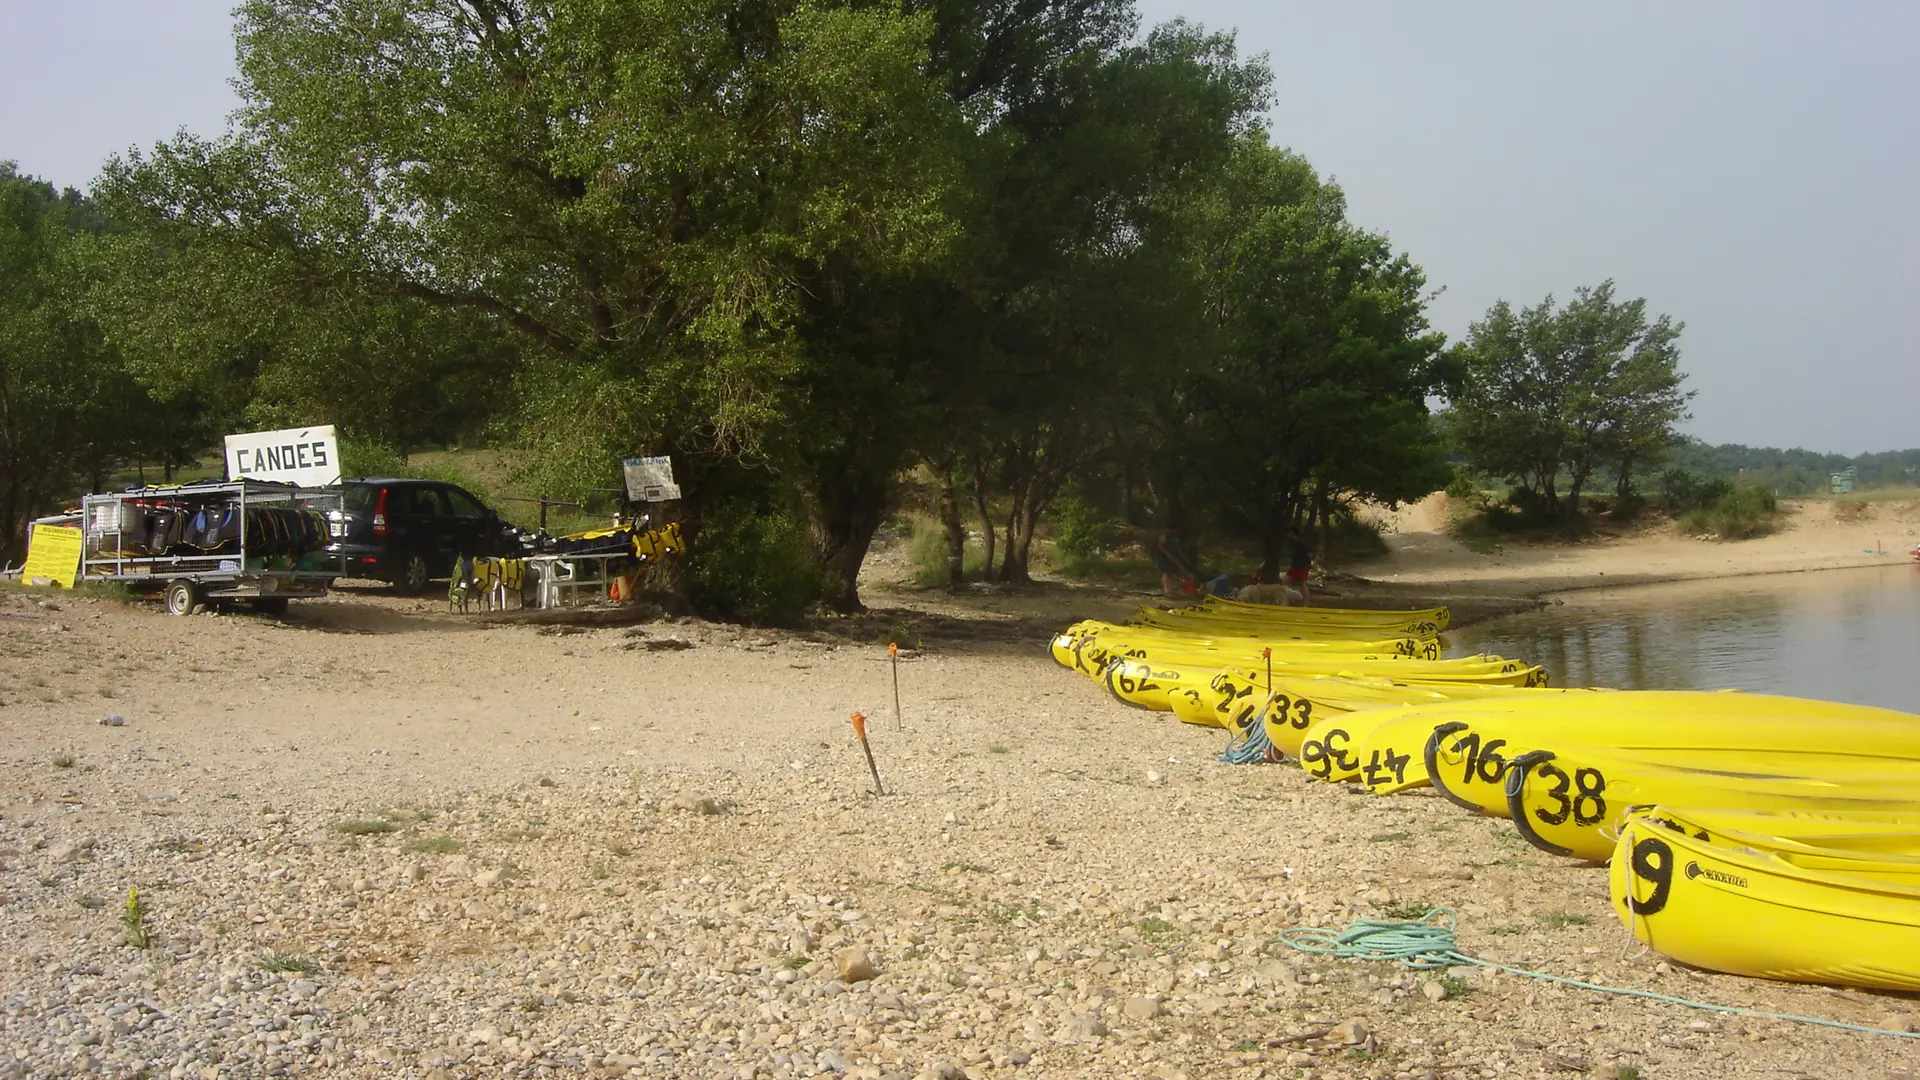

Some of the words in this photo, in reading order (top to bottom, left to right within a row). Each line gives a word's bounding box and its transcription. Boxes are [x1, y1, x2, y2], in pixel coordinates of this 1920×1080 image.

[237, 431, 327, 474] CANOÉS
[1435, 609, 1448, 620] 20
[1423, 643, 1437, 661] 19
[1120, 664, 1160, 693] 62
[1271, 694, 1312, 730] 33
[1450, 732, 1507, 784] 16
[1534, 763, 1607, 827] 38
[1623, 838, 1674, 916] 9
[1703, 868, 1748, 888] CANADIA
